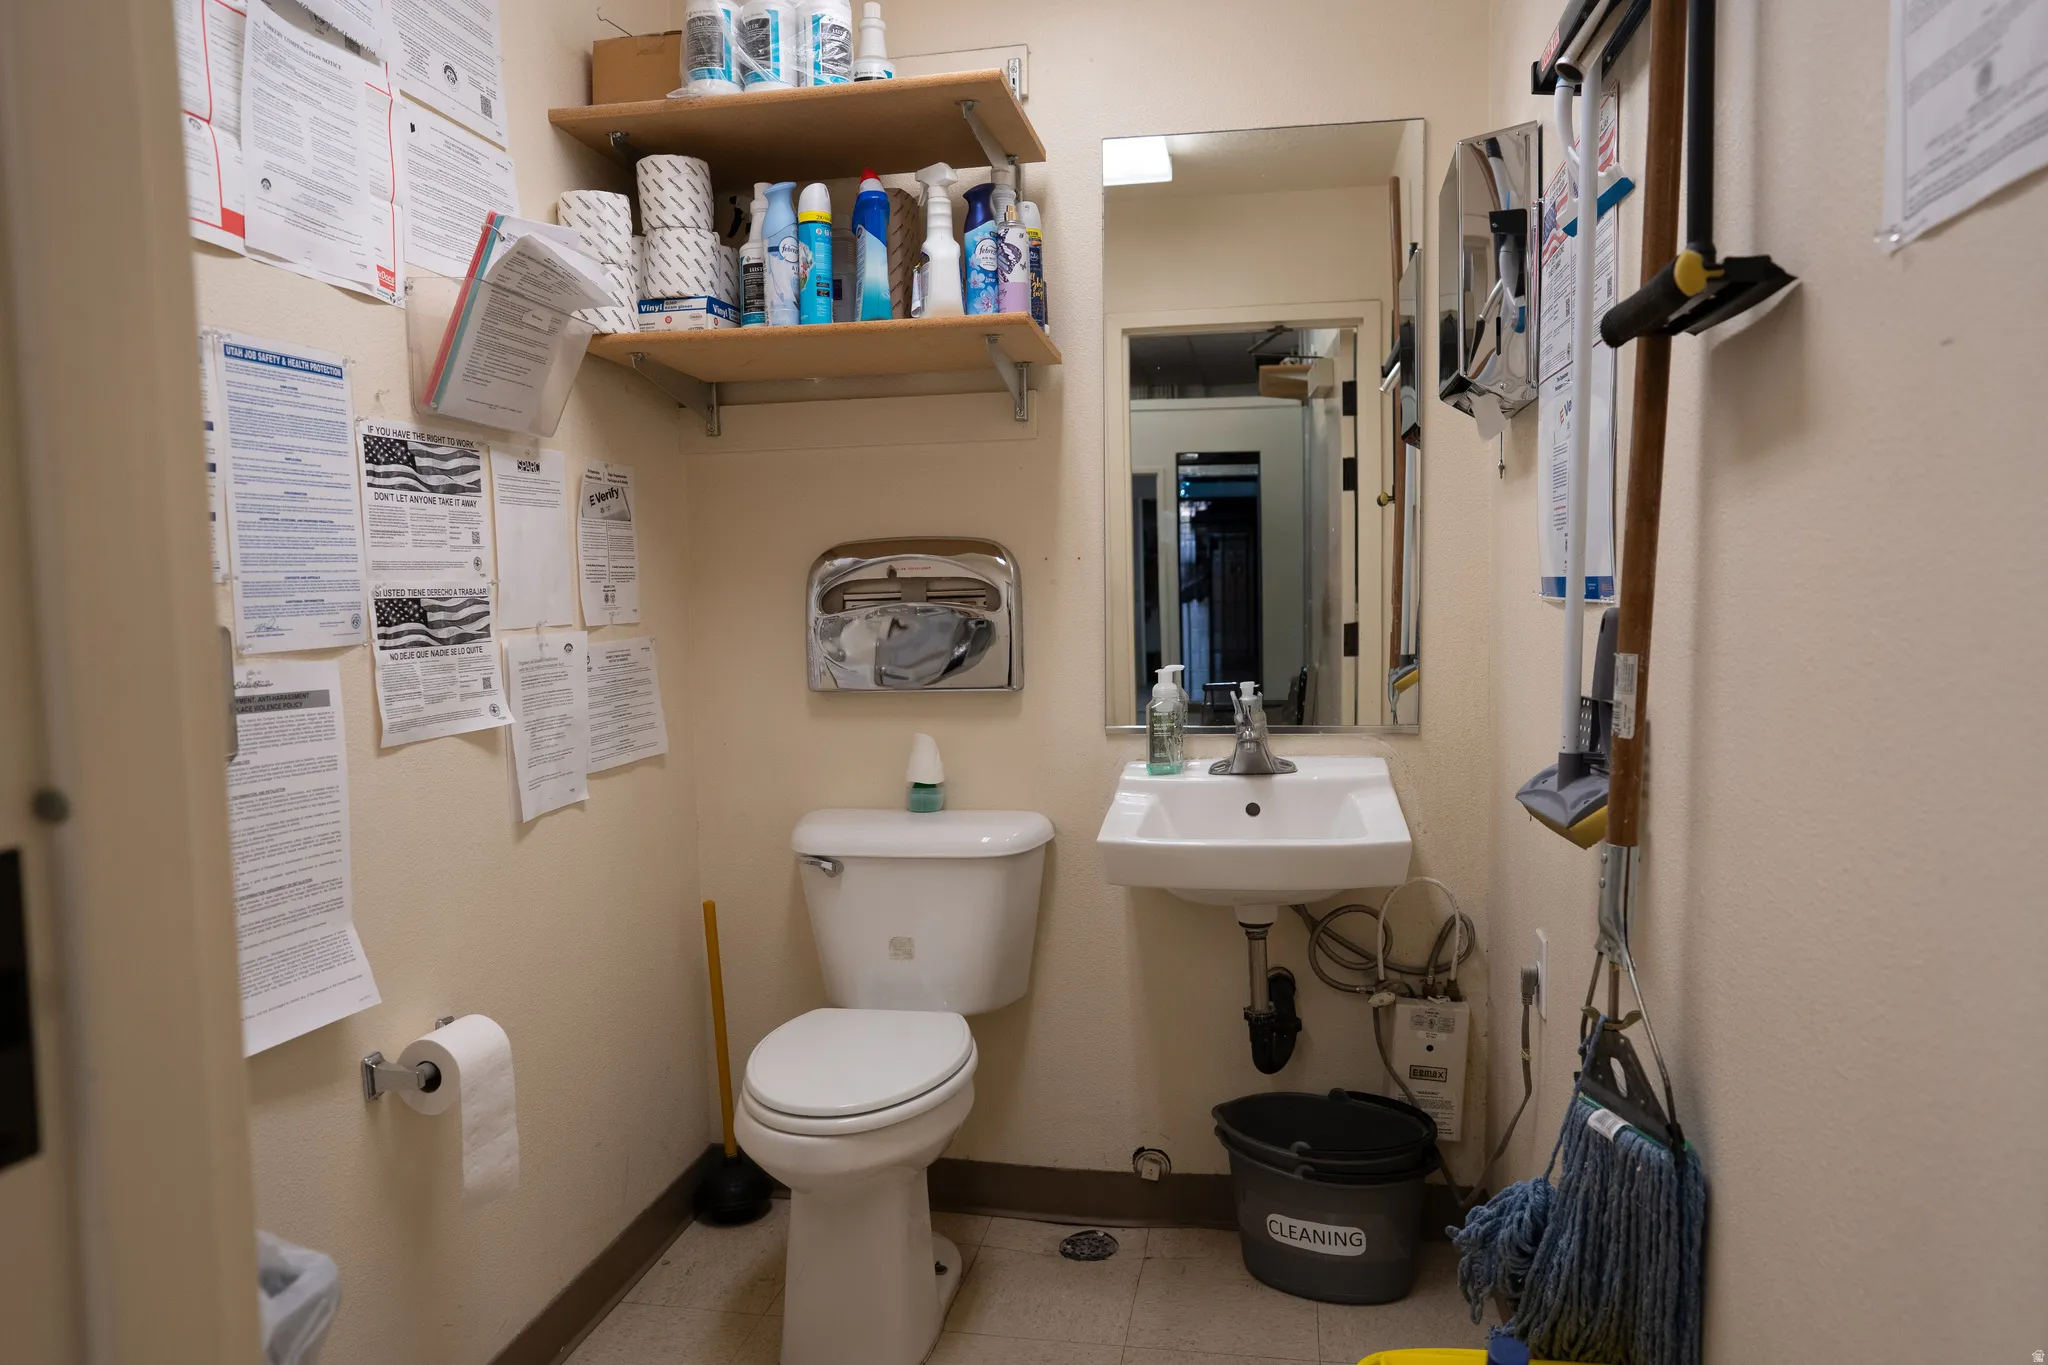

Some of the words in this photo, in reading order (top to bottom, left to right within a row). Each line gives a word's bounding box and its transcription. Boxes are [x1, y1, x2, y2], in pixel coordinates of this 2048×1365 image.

[641, 303, 663, 312] Vinyl
[712, 303, 728, 318] Vinyl
[225, 346, 243, 358] UTAH
[244, 349, 257, 360] JOB
[257, 351, 281, 365] SAFETY
[281, 356, 287, 366] &
[287, 357, 310, 371] HEALTH
[310, 361, 342, 377] PROTECTION
[367, 425, 374, 434] IF
[375, 426, 392, 437] YOU
[392, 429, 411, 440] HAVE
[412, 431, 426, 442] THE
[426, 433, 445, 444] RIGHT
[446, 436, 455, 446] TO
[455, 437, 475, 449] WORK
[374, 491, 394, 502] DON'T
[396, 493, 409, 503] LET
[409, 495, 437, 505] ANYONE
[438, 497, 453, 507] TAKE
[454, 498, 461, 507] IT
[461, 499, 477, 508] AWAY
[374, 588, 382, 598] SI
[382, 588, 406, 597] USTED
[408, 588, 426, 597] TIENE
[426, 588, 453, 597] DERECHO
[453, 588, 458, 596] A
[458, 588, 487, 596] TRABAJAR
[389, 652, 399, 661] NO
[399, 651, 415, 660] DEJE
[416, 650, 429, 659] QUE
[430, 648, 450, 658] NADIE
[450, 647, 457, 656] SE
[458, 647, 465, 655] LO
[465, 645, 484, 655] QUITE
[257, 692, 310, 703] ANTI-HARASSMENT
[253, 703, 282, 713] VIOLENCE
[282, 701, 303, 711] POLICY
[1412, 1068, 1444, 1080] Eemax
[1268, 1219, 1363, 1248] CLEANING
